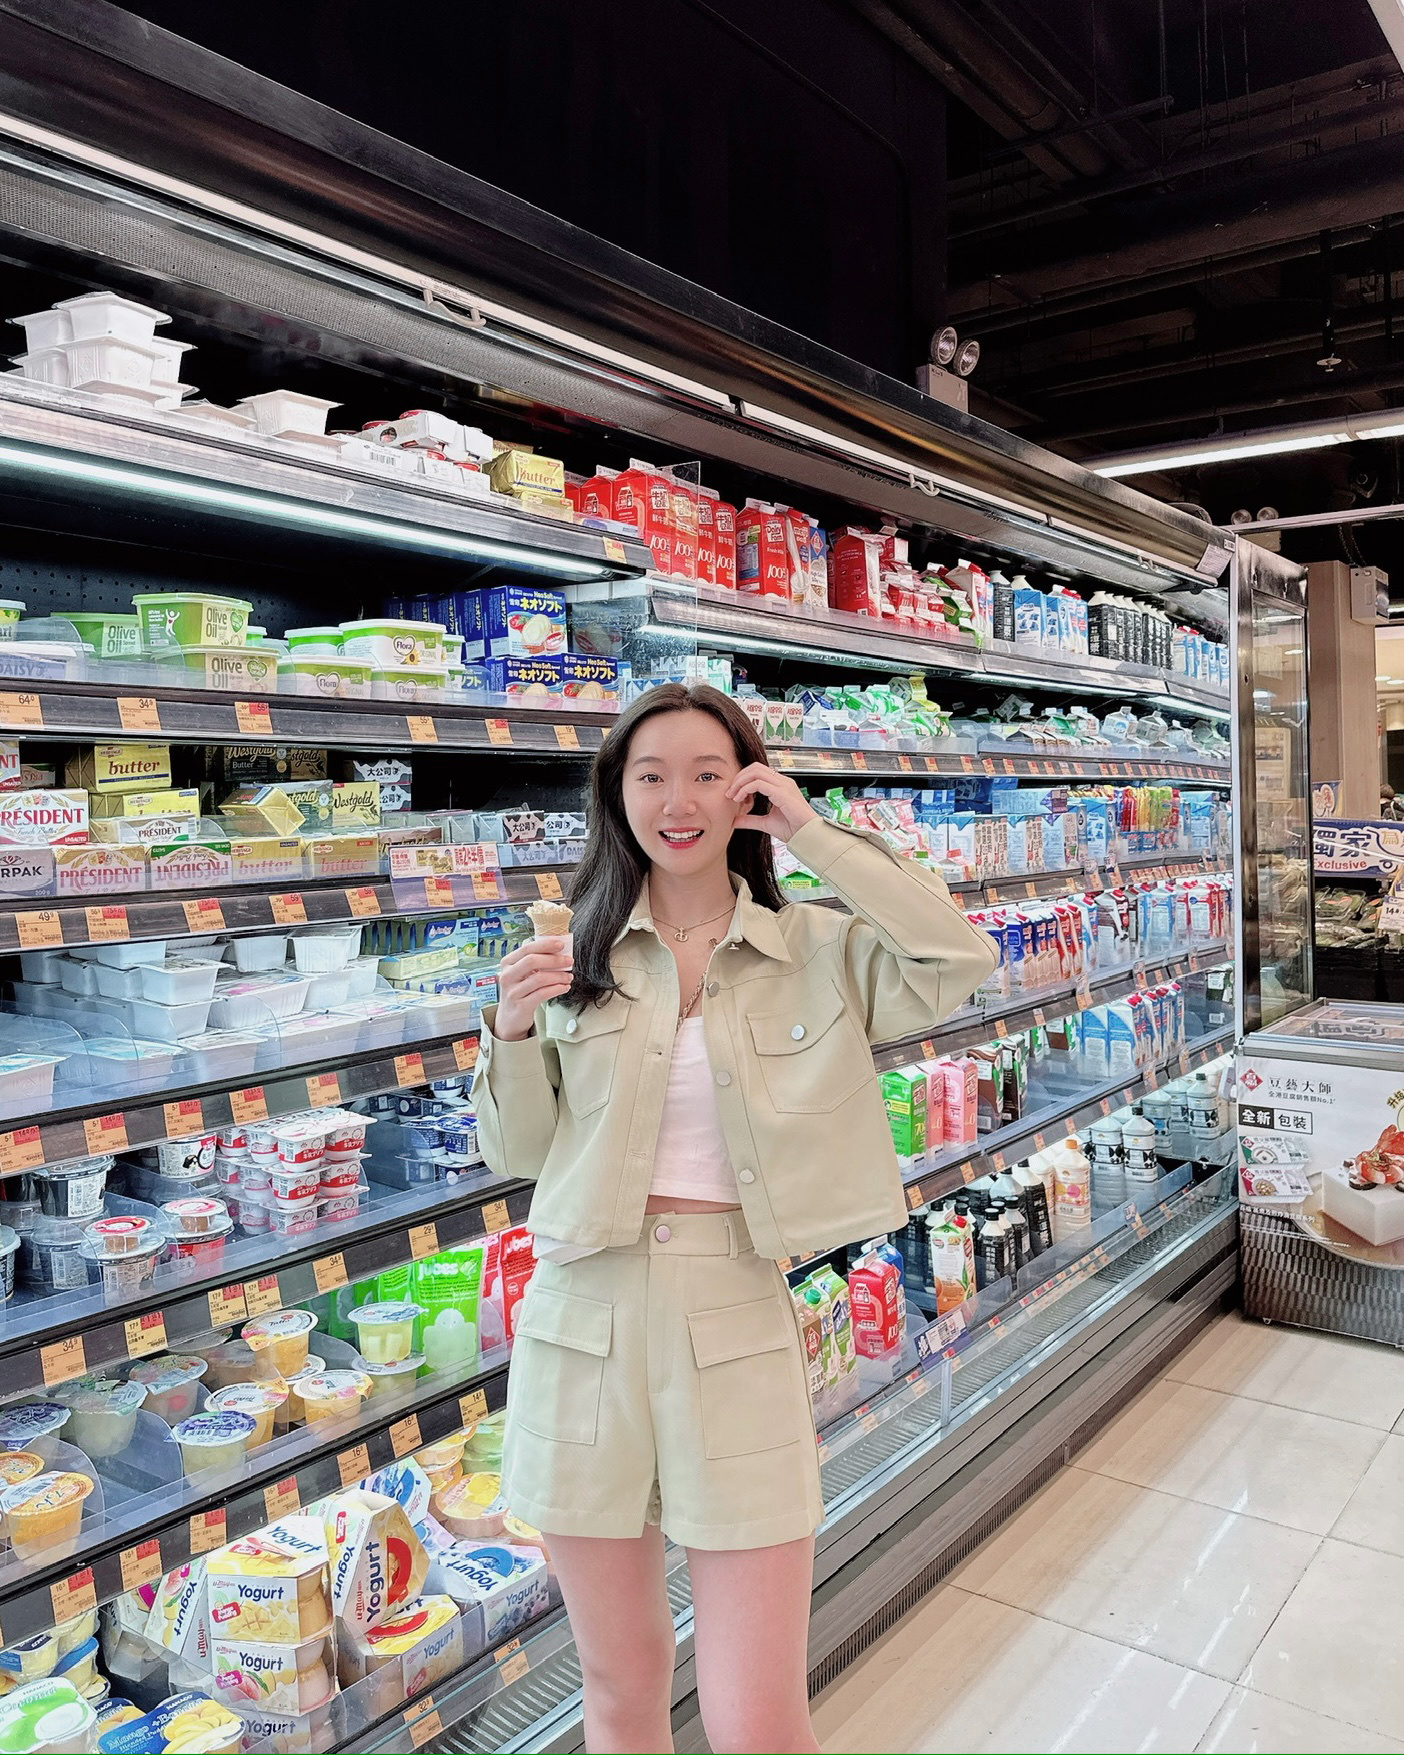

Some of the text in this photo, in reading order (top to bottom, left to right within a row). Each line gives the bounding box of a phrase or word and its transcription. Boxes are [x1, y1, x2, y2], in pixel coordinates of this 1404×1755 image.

[520, 597, 563, 613] ネオソフト
[205, 607, 228, 625] Olive
[107, 625, 137, 640] Olive
[205, 622, 218, 638] Oil
[107, 640, 122, 653] Oil
[396, 639, 413, 651] Flora
[211, 657, 243, 673] Olive
[573, 665, 616, 680] ネオソフト
[319, 678, 337, 688] Flora
[518, 669, 560, 683] ネオソフト
[232, 761, 254, 769] Butter
[291, 750, 321, 767] stgold
[108, 760, 160, 776] butter
[367, 766, 392, 777] 大公司
[333, 790, 375, 814] Westgold
[0, 807, 85, 829] RÉSIDENT
[545, 820, 563, 830] 公司
[138, 826, 183, 838] PRÉSIDENT
[512, 822, 531, 833] 大公司
[0, 865, 42, 879] RPAK
[155, 859, 229, 882] PRÉSIDENT
[238, 860, 293, 875] butter
[320, 857, 368, 873] butter
[1313, 860, 1368, 870] xclusive
[60, 865, 143, 891] PRÉSIDENT
[1269, 1076, 1333, 1095] 豆藝大師
[1242, 1108, 1307, 1130] 全新 包裝
[502, 1233, 533, 1261] jubes
[418, 1260, 459, 1281] jubes
[267, 1525, 323, 1554] Yogurt
[334, 1546, 356, 1599] Yogurt
[446, 1560, 499, 1591] Yogurt
[365, 1541, 385, 1623] Yogurt
[238, 1585, 284, 1602] Yogurt
[506, 1580, 540, 1606] Yogurt
[174, 1582, 198, 1636] Yogurt
[423, 1627, 455, 1659] Yogurt
[239, 1652, 284, 1672] Yogurt
[246, 1719, 296, 1737] Yogurt
